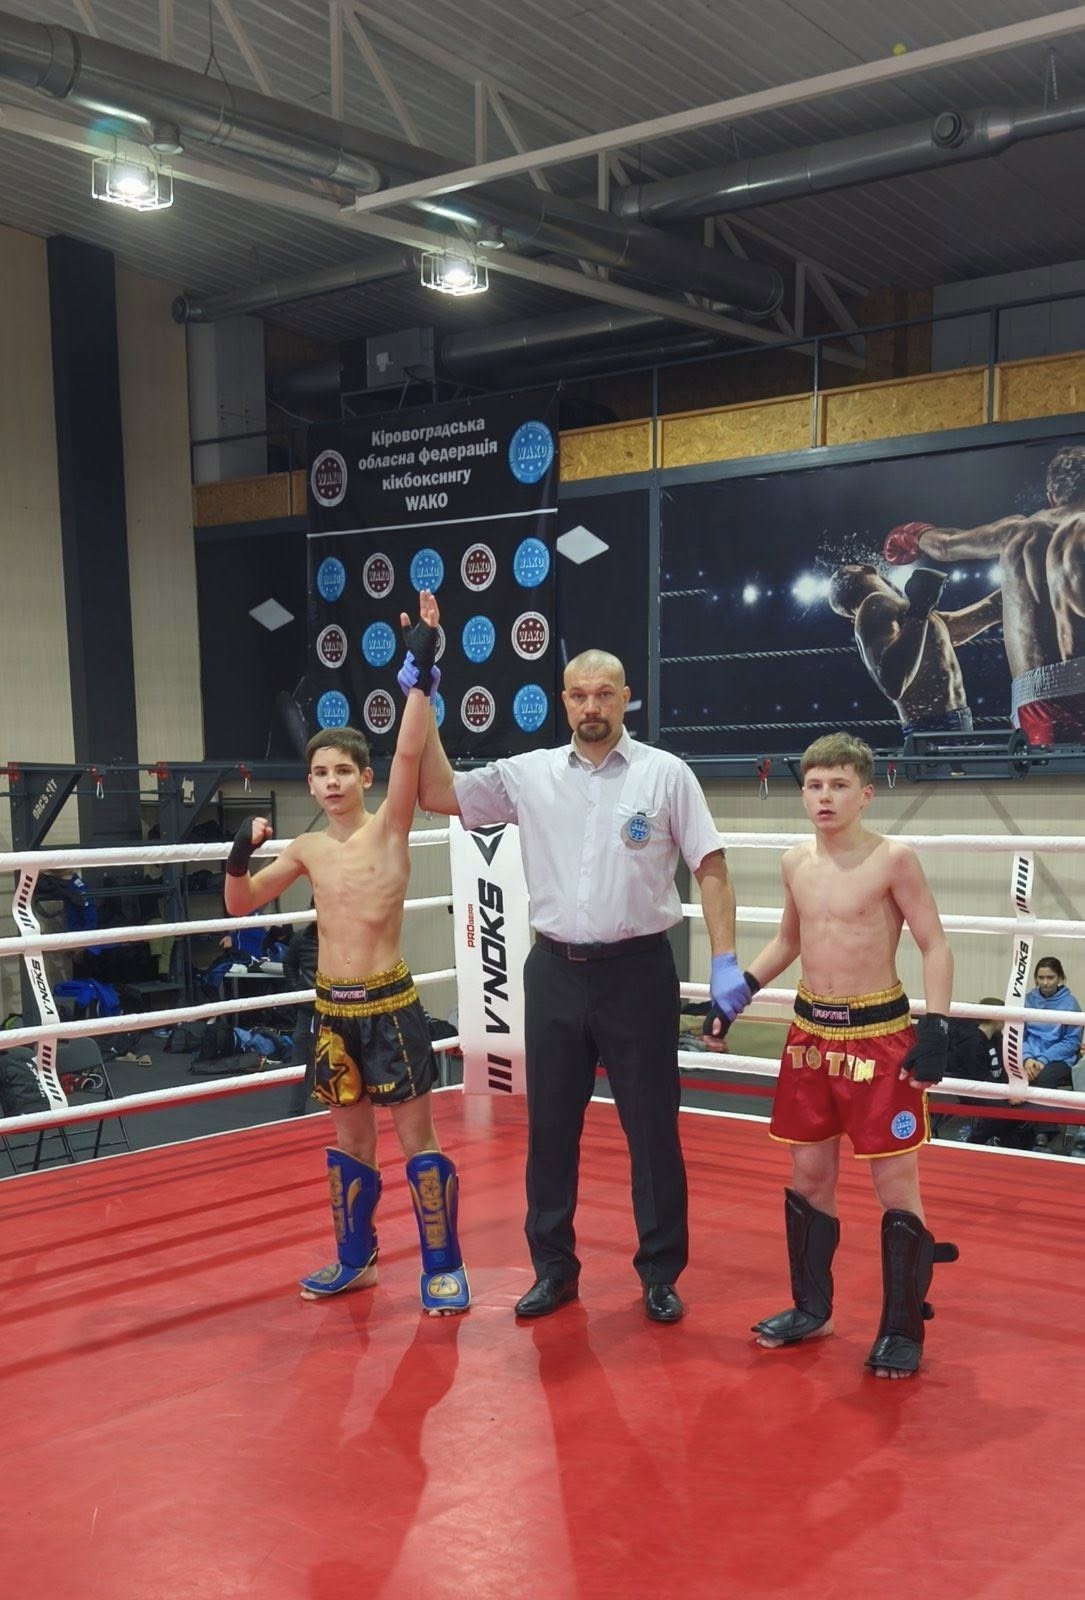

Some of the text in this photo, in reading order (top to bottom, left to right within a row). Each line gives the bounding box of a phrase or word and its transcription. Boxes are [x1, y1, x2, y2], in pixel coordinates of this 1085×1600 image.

[371, 418, 485, 448] Кіровоградська
[358, 438, 498, 470] обласна федерація
[517, 445, 548, 460] WAKO
[382, 468, 472, 490] кікбоксингу
[404, 492, 448, 511] WAKO
[468, 561, 491, 574] WAKO
[519, 630, 545, 642] WAKO
[369, 639, 391, 650] WAKO
[370, 705, 391, 718] WAKO
[467, 704, 490, 715] WAKO
[521, 703, 543, 714] WAKO
[417, 1166, 444, 1211] TOP
